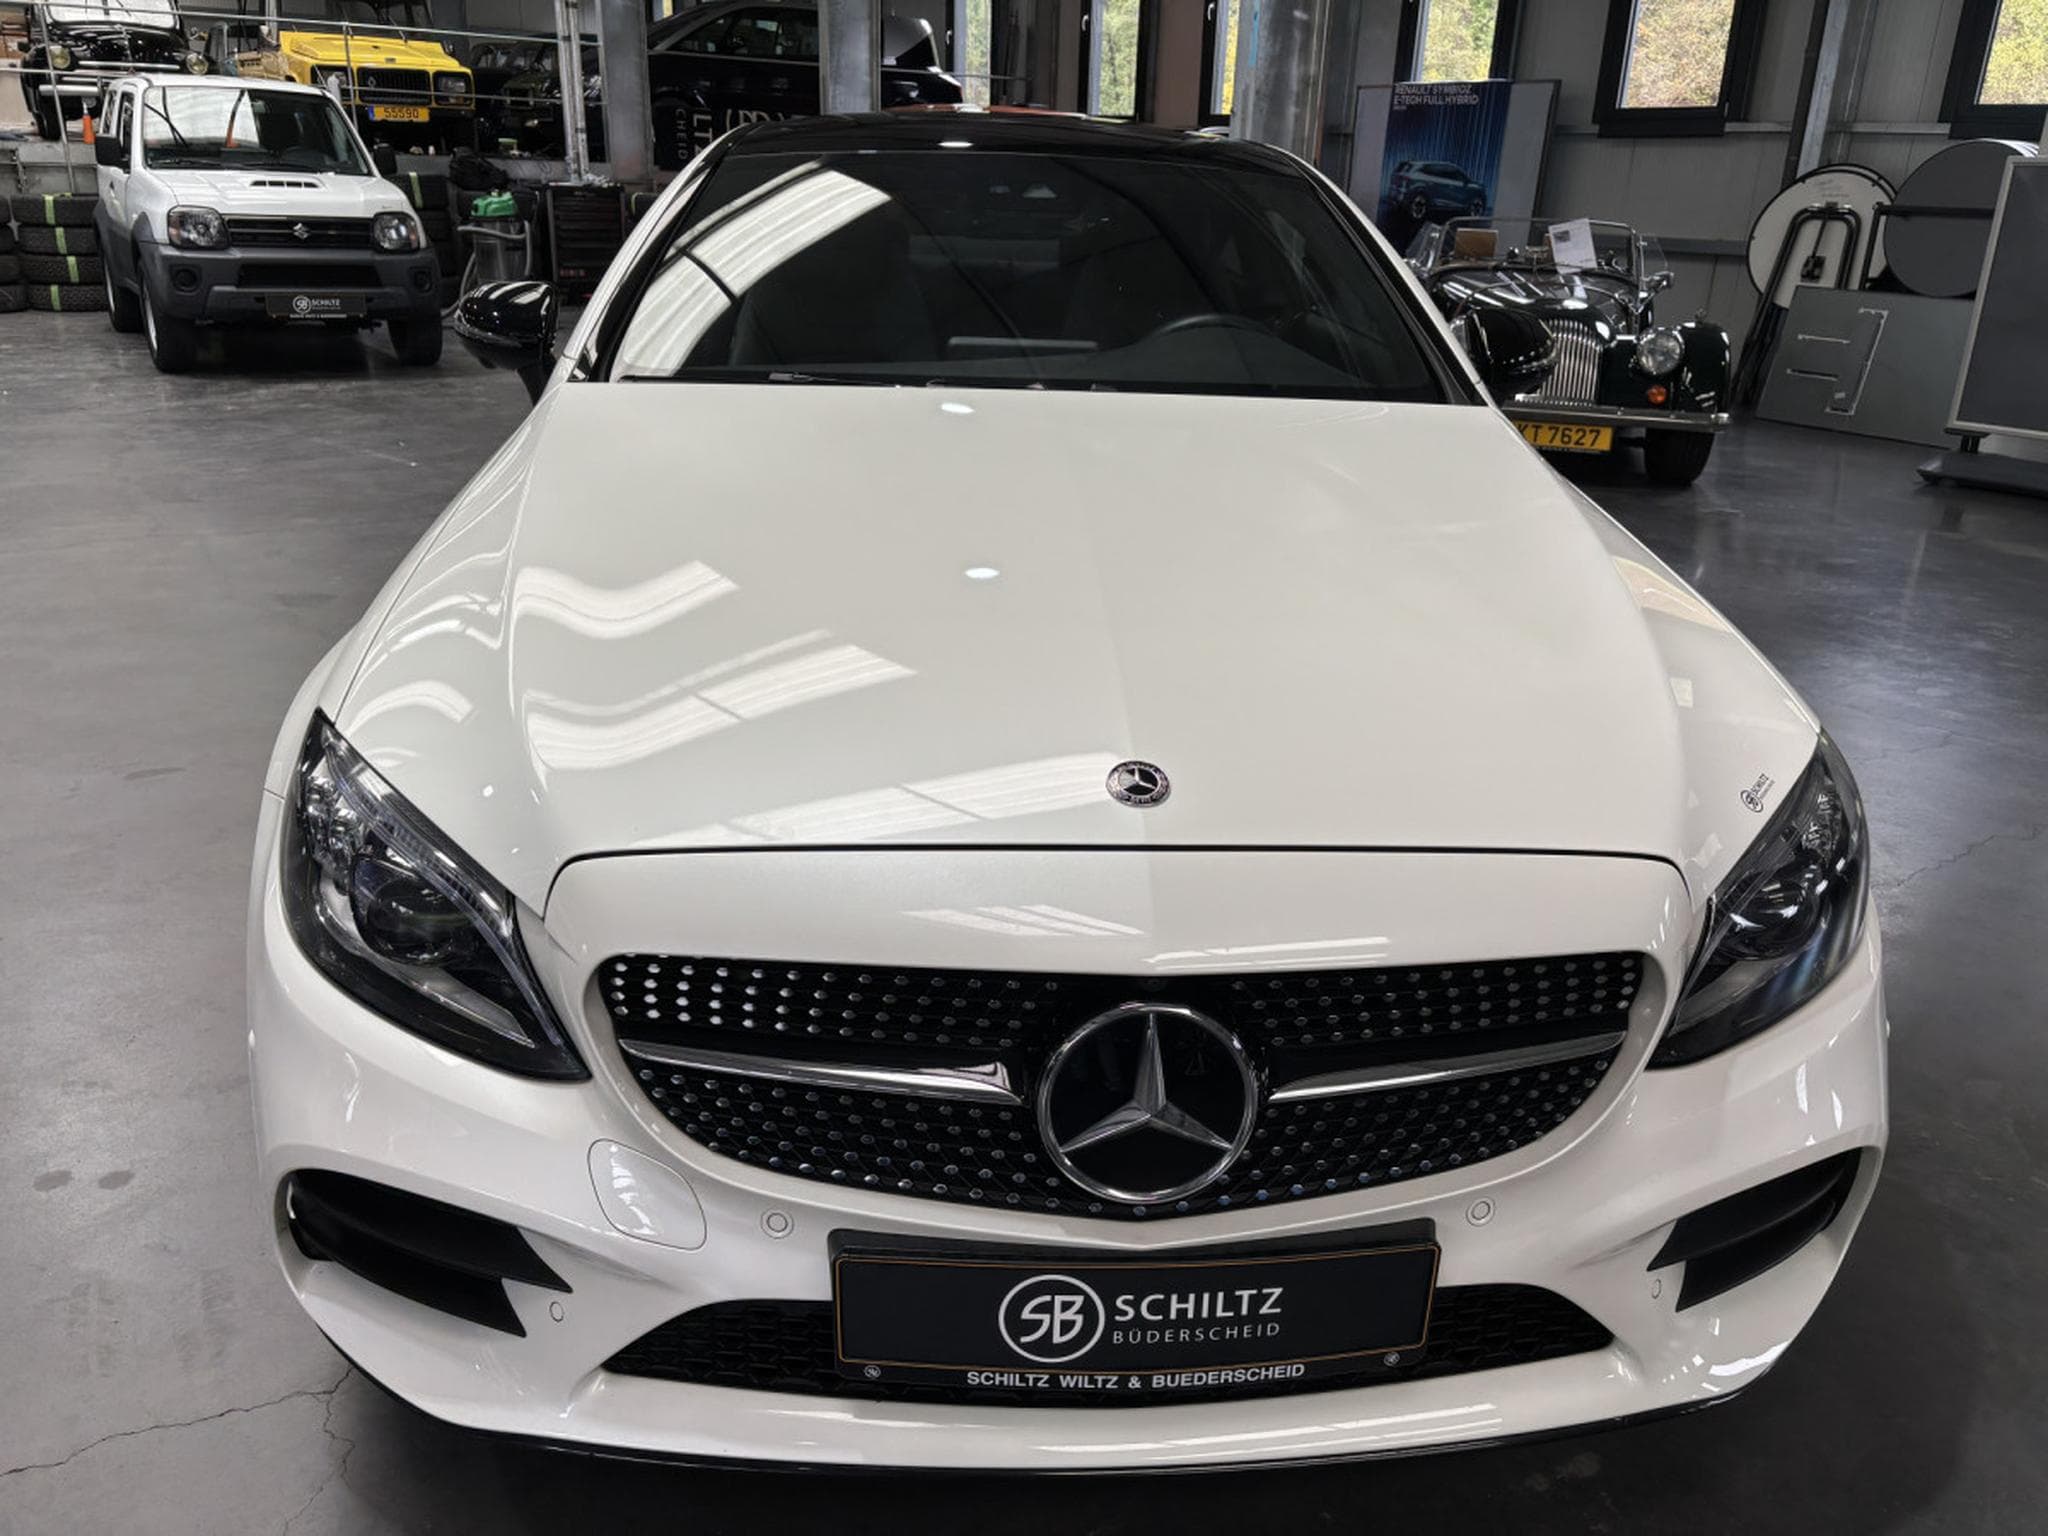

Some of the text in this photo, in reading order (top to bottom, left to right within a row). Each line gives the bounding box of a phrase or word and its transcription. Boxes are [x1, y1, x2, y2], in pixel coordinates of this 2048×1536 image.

[1423, 95, 1443, 104] FULL
[1548, 426, 1600, 446] 7627
[1114, 1287, 1283, 1322] SCHILTZ
[1112, 1322, 1280, 1344] BÜDERSCHEID
[967, 1363, 1305, 1389] SCHILTZ WILTZ & BUEDERSCHEID
